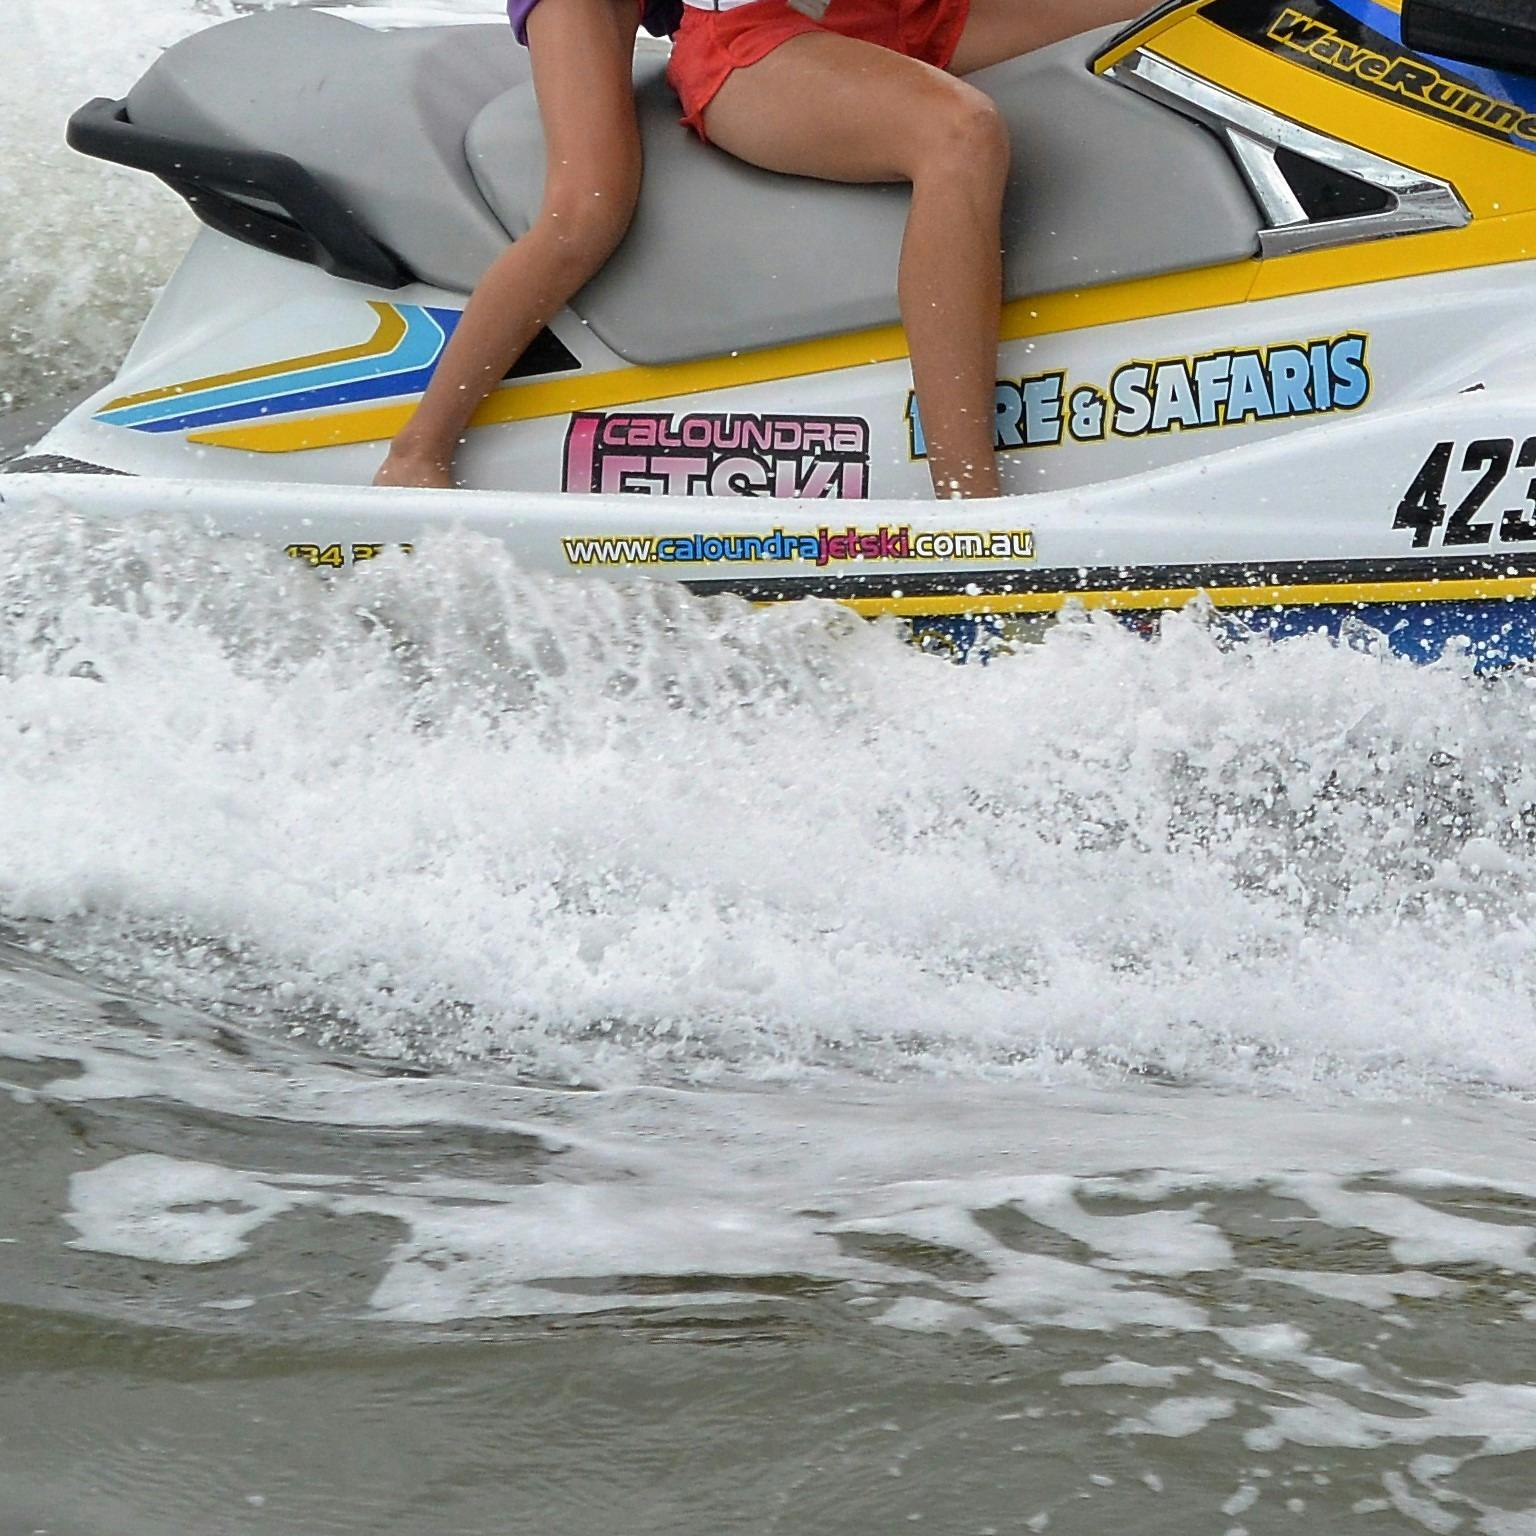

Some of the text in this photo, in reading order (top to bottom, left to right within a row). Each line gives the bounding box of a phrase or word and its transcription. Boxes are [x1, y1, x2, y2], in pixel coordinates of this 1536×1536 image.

[1068, 386, 1106, 440] &
[1109, 331, 1372, 438] SAFARIS
[601, 417, 867, 452] CALOUNDRA
[564, 528, 1034, 565] www.caloundrajetski.com.au
